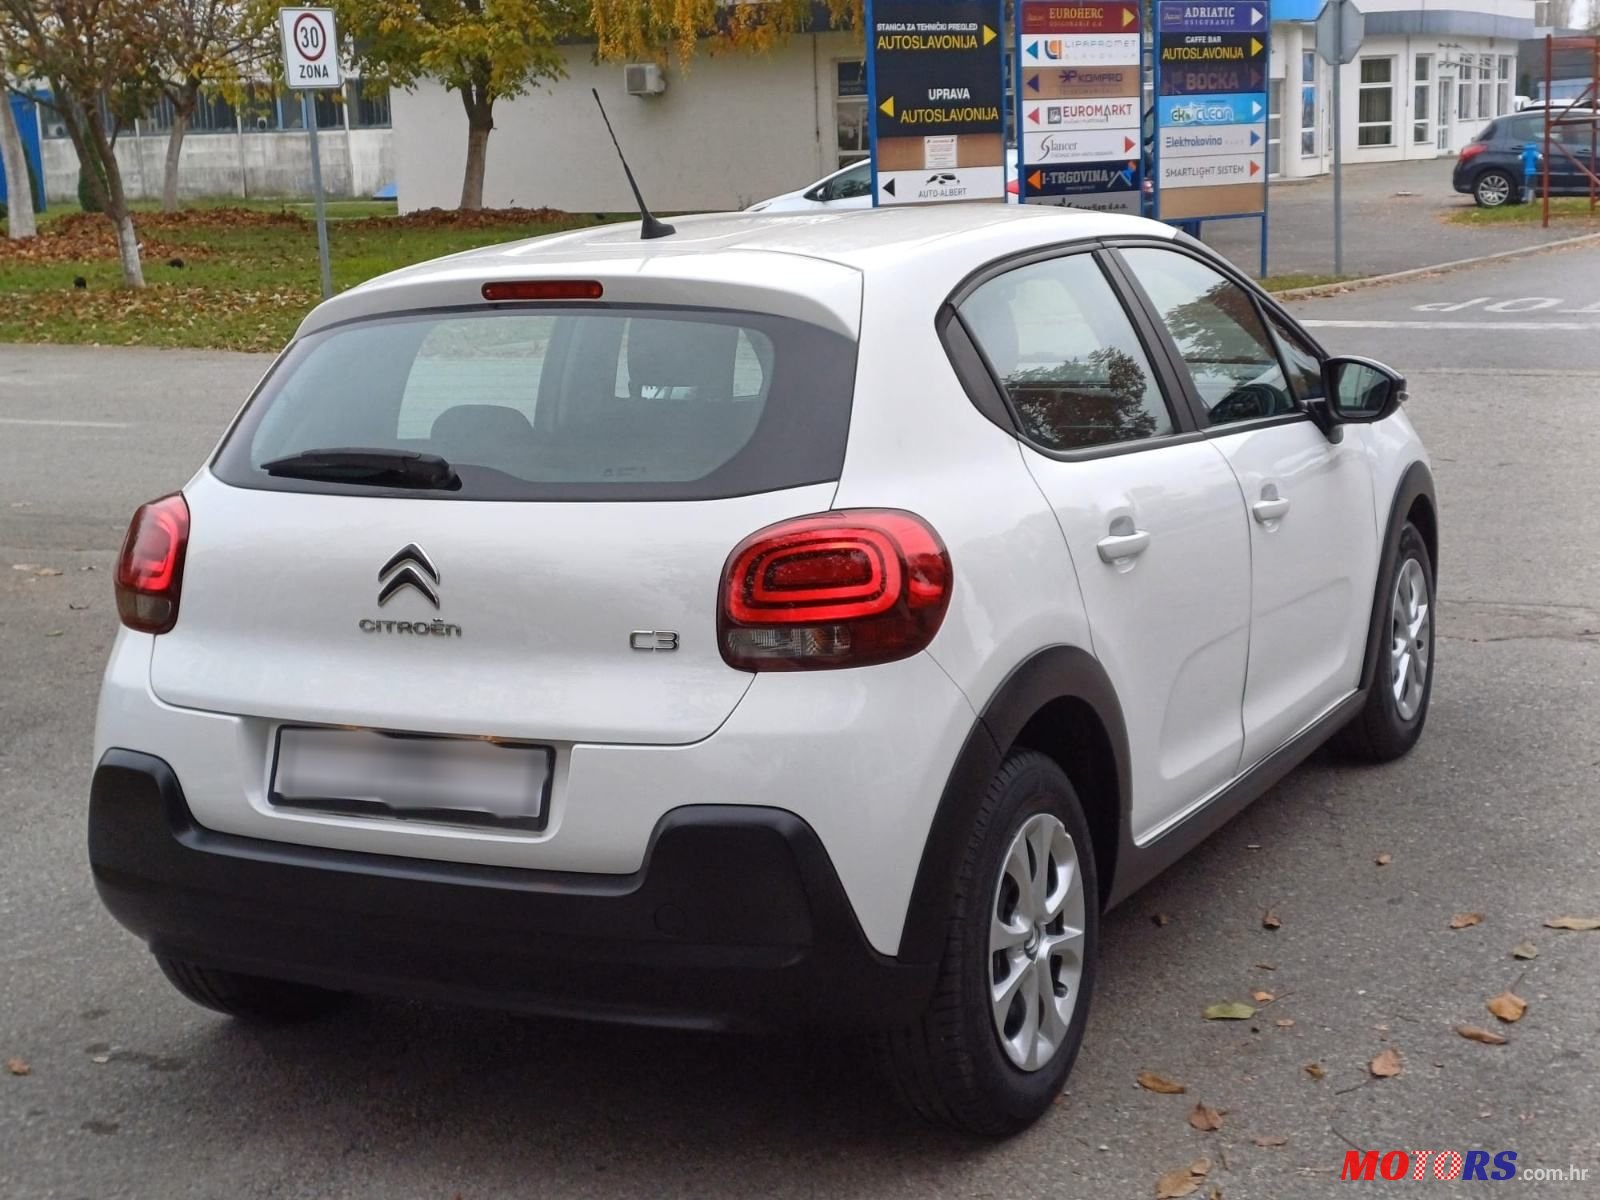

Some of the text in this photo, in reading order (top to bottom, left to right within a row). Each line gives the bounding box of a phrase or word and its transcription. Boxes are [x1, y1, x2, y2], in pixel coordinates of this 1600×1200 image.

[1049, 7, 1104, 19] EUROHERC
[1184, 7, 1235, 18] ADRIATIC
[877, 23, 905, 31] STANICA
[906, 23, 916, 31] ZA
[948, 23, 978, 31] PREGLED
[300, 26, 319, 48] 30
[877, 35, 978, 50] AUTOSLAVONIJA
[1162, 47, 1244, 60] AUTOSLAVONIJA
[299, 64, 329, 79] ZONA
[928, 88, 970, 100] UPRAVA
[901, 107, 999, 123] AUTOSLAVONIJA
[1063, 104, 1133, 121] EUROMARKT
[1217, 164, 1245, 175] SISTEM
[629, 629, 680, 651] C3
